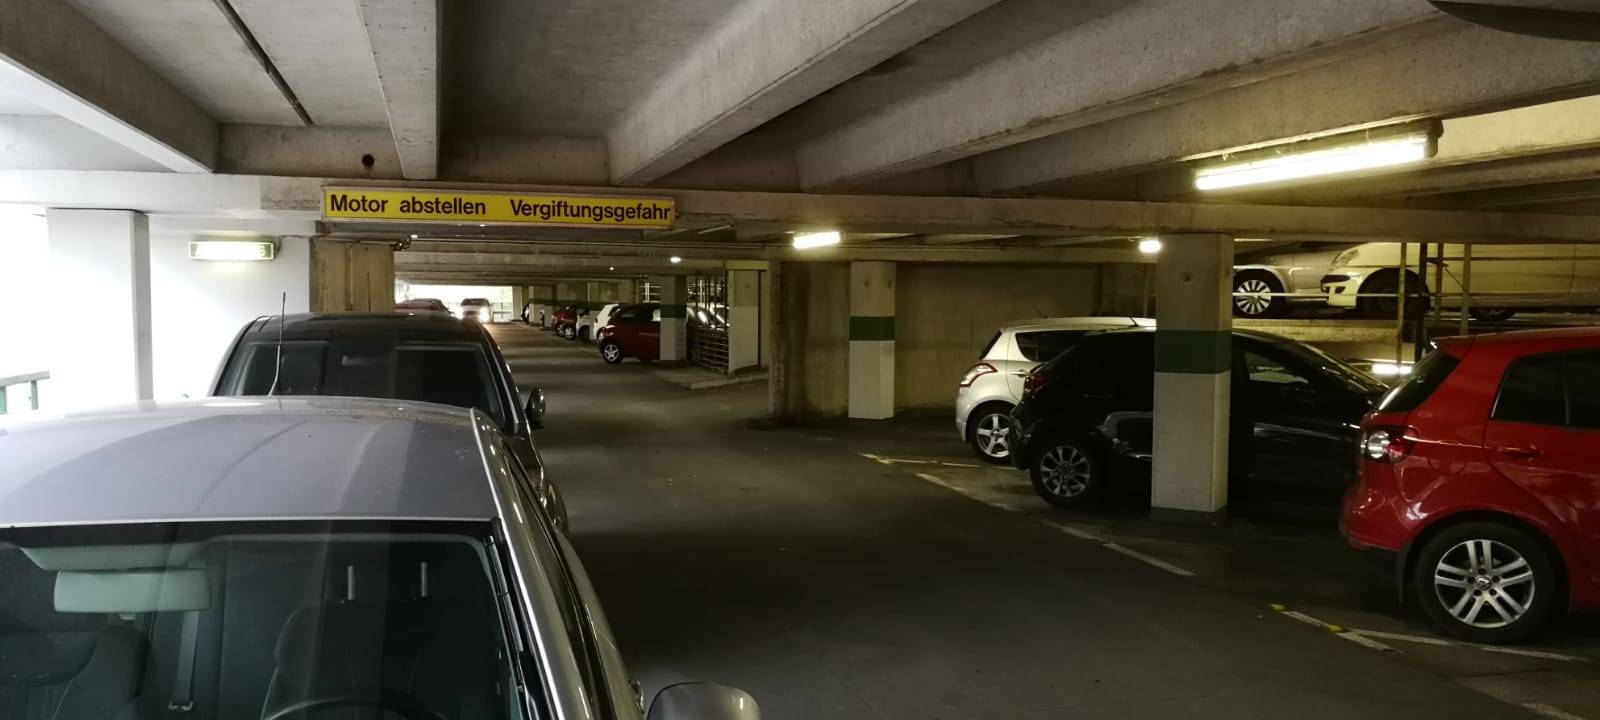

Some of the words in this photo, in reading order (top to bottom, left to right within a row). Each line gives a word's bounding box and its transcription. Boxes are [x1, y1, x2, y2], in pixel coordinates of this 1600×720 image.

[330, 194, 388, 212] Motor
[400, 196, 486, 215] abstellen
[510, 198, 671, 222] Vergiftungsgefahr
